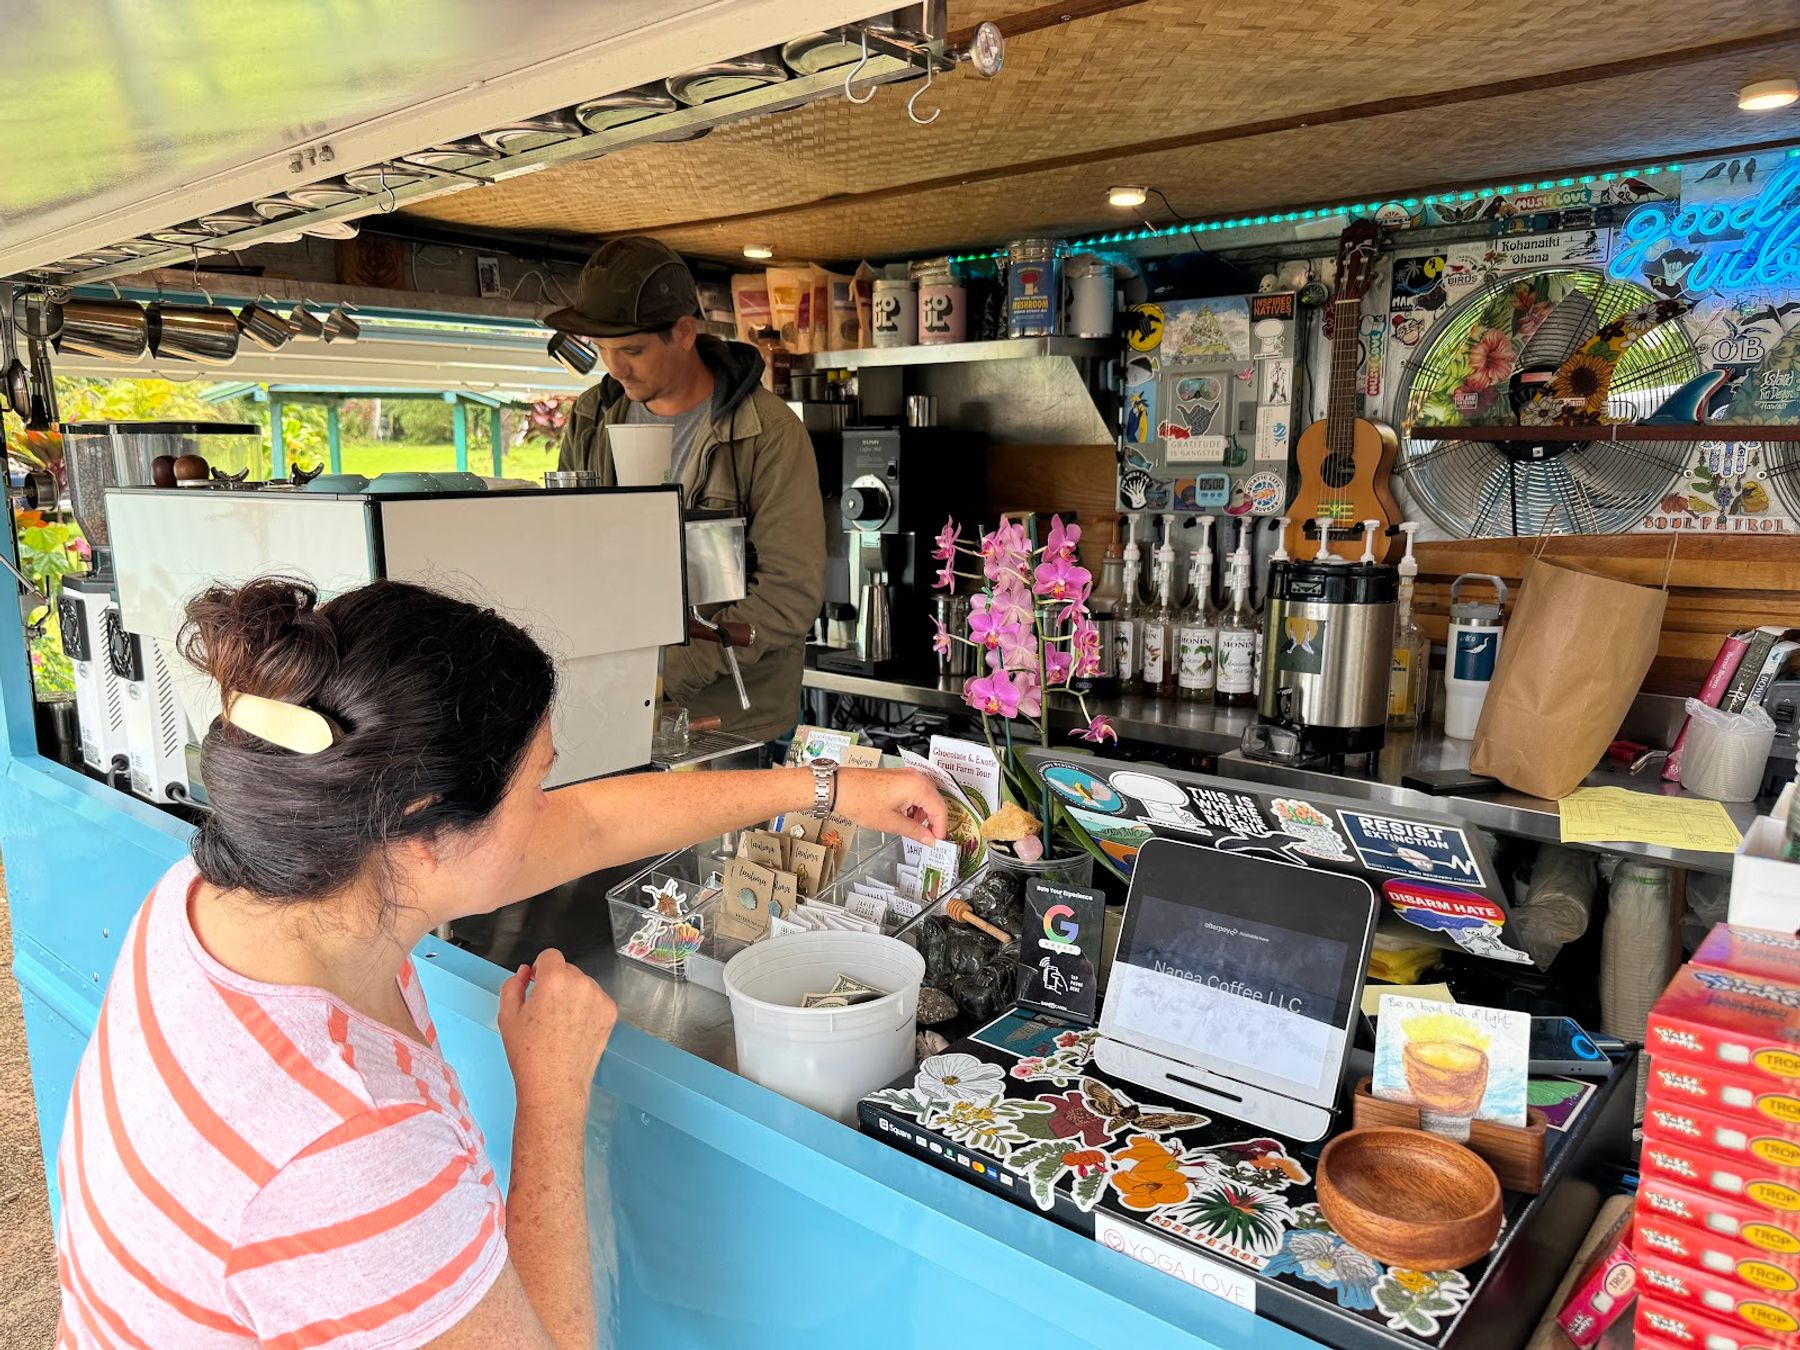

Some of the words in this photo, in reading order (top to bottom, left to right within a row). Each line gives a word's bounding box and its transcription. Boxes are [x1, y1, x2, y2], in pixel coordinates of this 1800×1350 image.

[1515, 196, 1551, 211] MUSH
[1555, 189, 1591, 206] LOVE
[1502, 236, 1560, 251] Kohanaiki
[1013, 300, 1049, 310] MUSHROOM
[1254, 295, 1292, 308] INSPIRED
[1254, 306, 1292, 316] NATIVES
[1760, 369, 1794, 387] Island
[1171, 440, 1221, 449] GRATITUDE
[1643, 516, 1696, 529] SOUL
[1700, 517, 1791, 533] PATROL
[1181, 637, 1210, 645] MONIN
[1223, 640, 1253, 649] MONIN
[933, 747, 966, 761] Chocolate
[968, 754, 974, 762] &
[975, 755, 997, 768] Exotic
[937, 759, 954, 771] Fruit
[956, 763, 975, 775] Farm
[976, 768, 992, 778] Tour
[1186, 787, 1231, 804] THIS
[1235, 795, 1255, 808] IS
[1193, 798, 1262, 818] WHERE
[1200, 807, 1220, 816] WE
[1223, 812, 1238, 820] DO
[1242, 815, 1266, 827] THE
[1205, 815, 1268, 835] MAGIC
[1358, 817, 1443, 841] RESIST
[1363, 830, 1449, 849] EXTINCTION
[1036, 885, 1049, 893] Rate
[1050, 887, 1062, 897] Your
[1063, 890, 1093, 901] Experience
[1389, 891, 1451, 911] DISARM
[1454, 904, 1497, 917] HATE
[1204, 922, 1231, 935] afterpay
[1154, 959, 1202, 984] Nanea
[1207, 975, 1263, 1002] Coffee
[1389, 997, 1402, 1009] Be
[1406, 1001, 1417, 1009] a
[1471, 1009, 1481, 1020] of
[888, 1124, 913, 1141] Square
[1759, 1184, 1796, 1203] TROP
[1151, 1215, 1193, 1236] SOUL
[1194, 1232, 1263, 1267] PATROL
[1753, 1228, 1791, 1246] TROP
[1129, 1241, 1186, 1279] YOGA
[1192, 1268, 1247, 1304] LOVE
[1608, 1268, 1627, 1290] TROP
[1749, 1266, 1787, 1283] TROP
[1751, 1307, 1788, 1324] TROP
